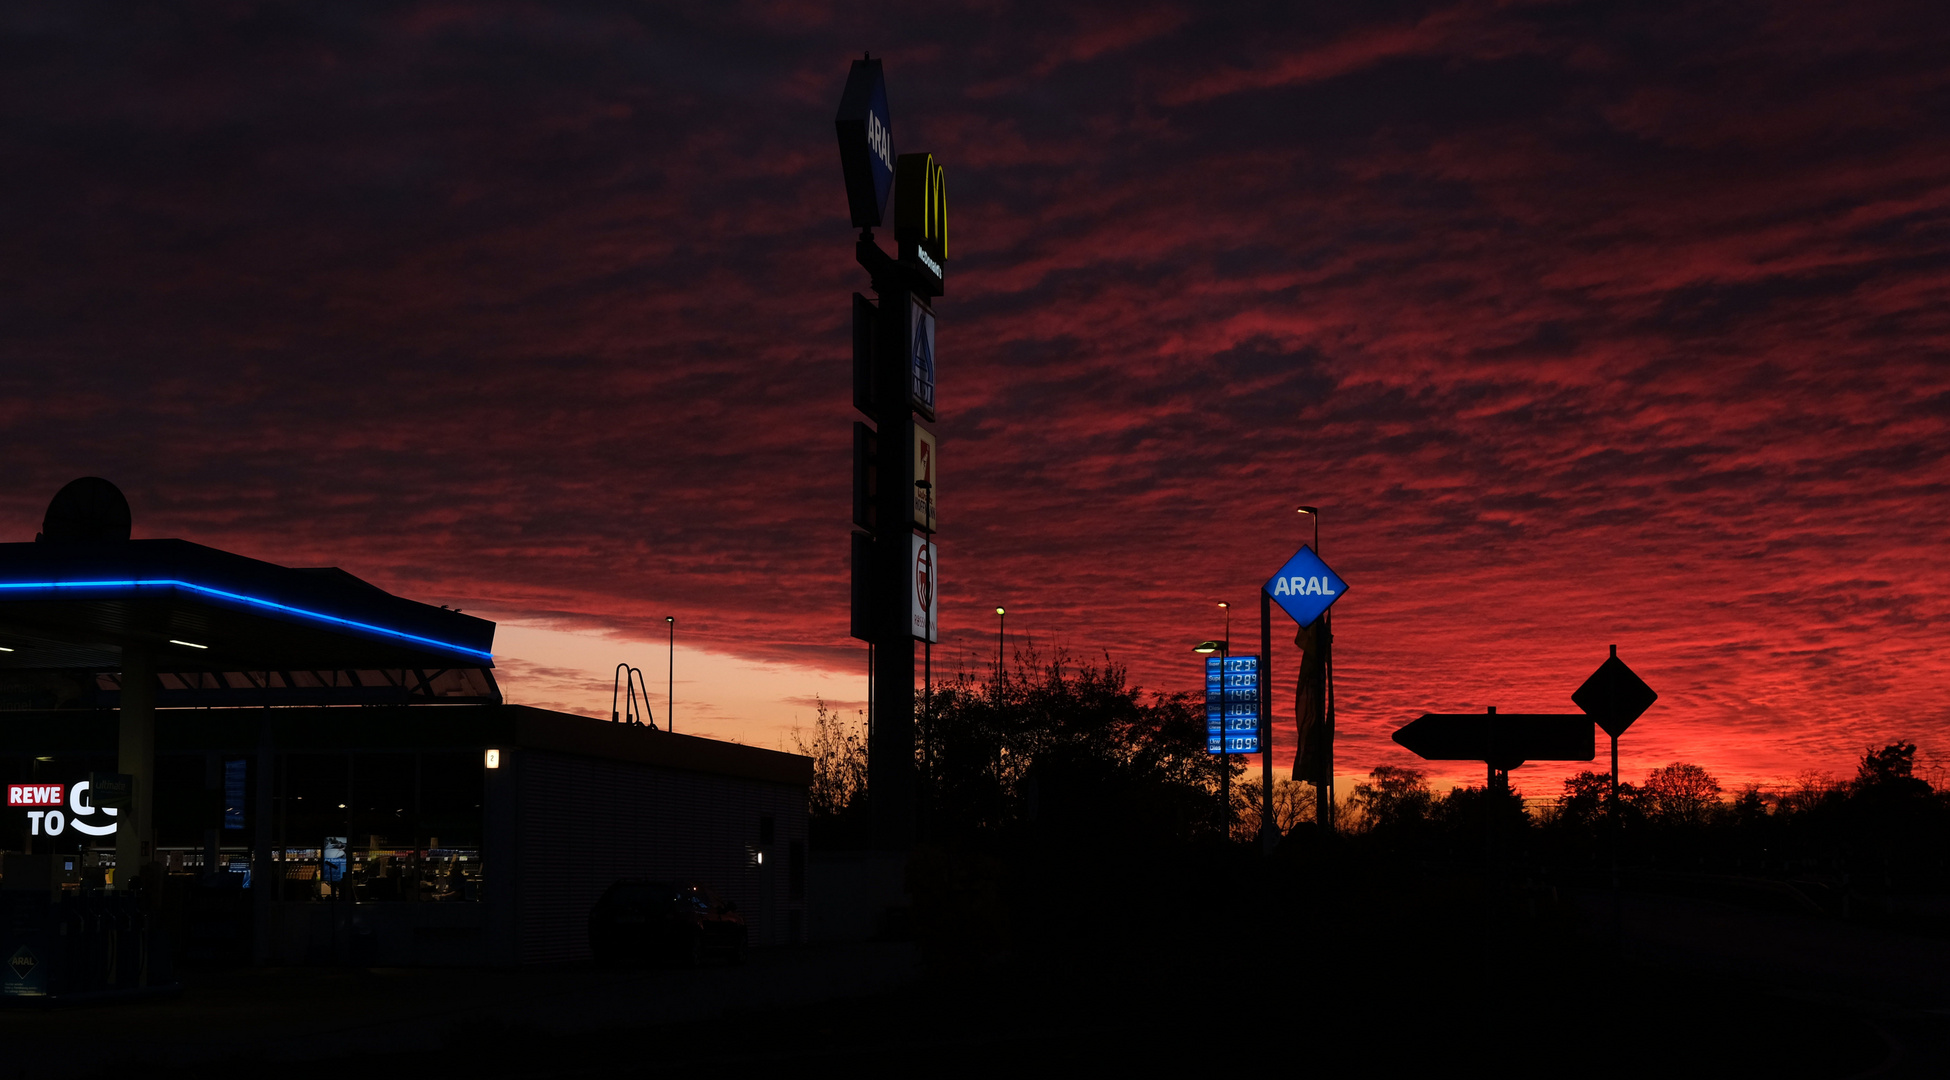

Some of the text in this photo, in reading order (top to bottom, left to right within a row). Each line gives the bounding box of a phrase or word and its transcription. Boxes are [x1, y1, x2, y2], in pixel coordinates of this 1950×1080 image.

[867, 109, 893, 173] ARAL
[1273, 576, 1336, 596] ARAL
[10, 786, 61, 804] REWE
[27, 810, 65, 836] TO
[11, 956, 35, 966] ARAL
